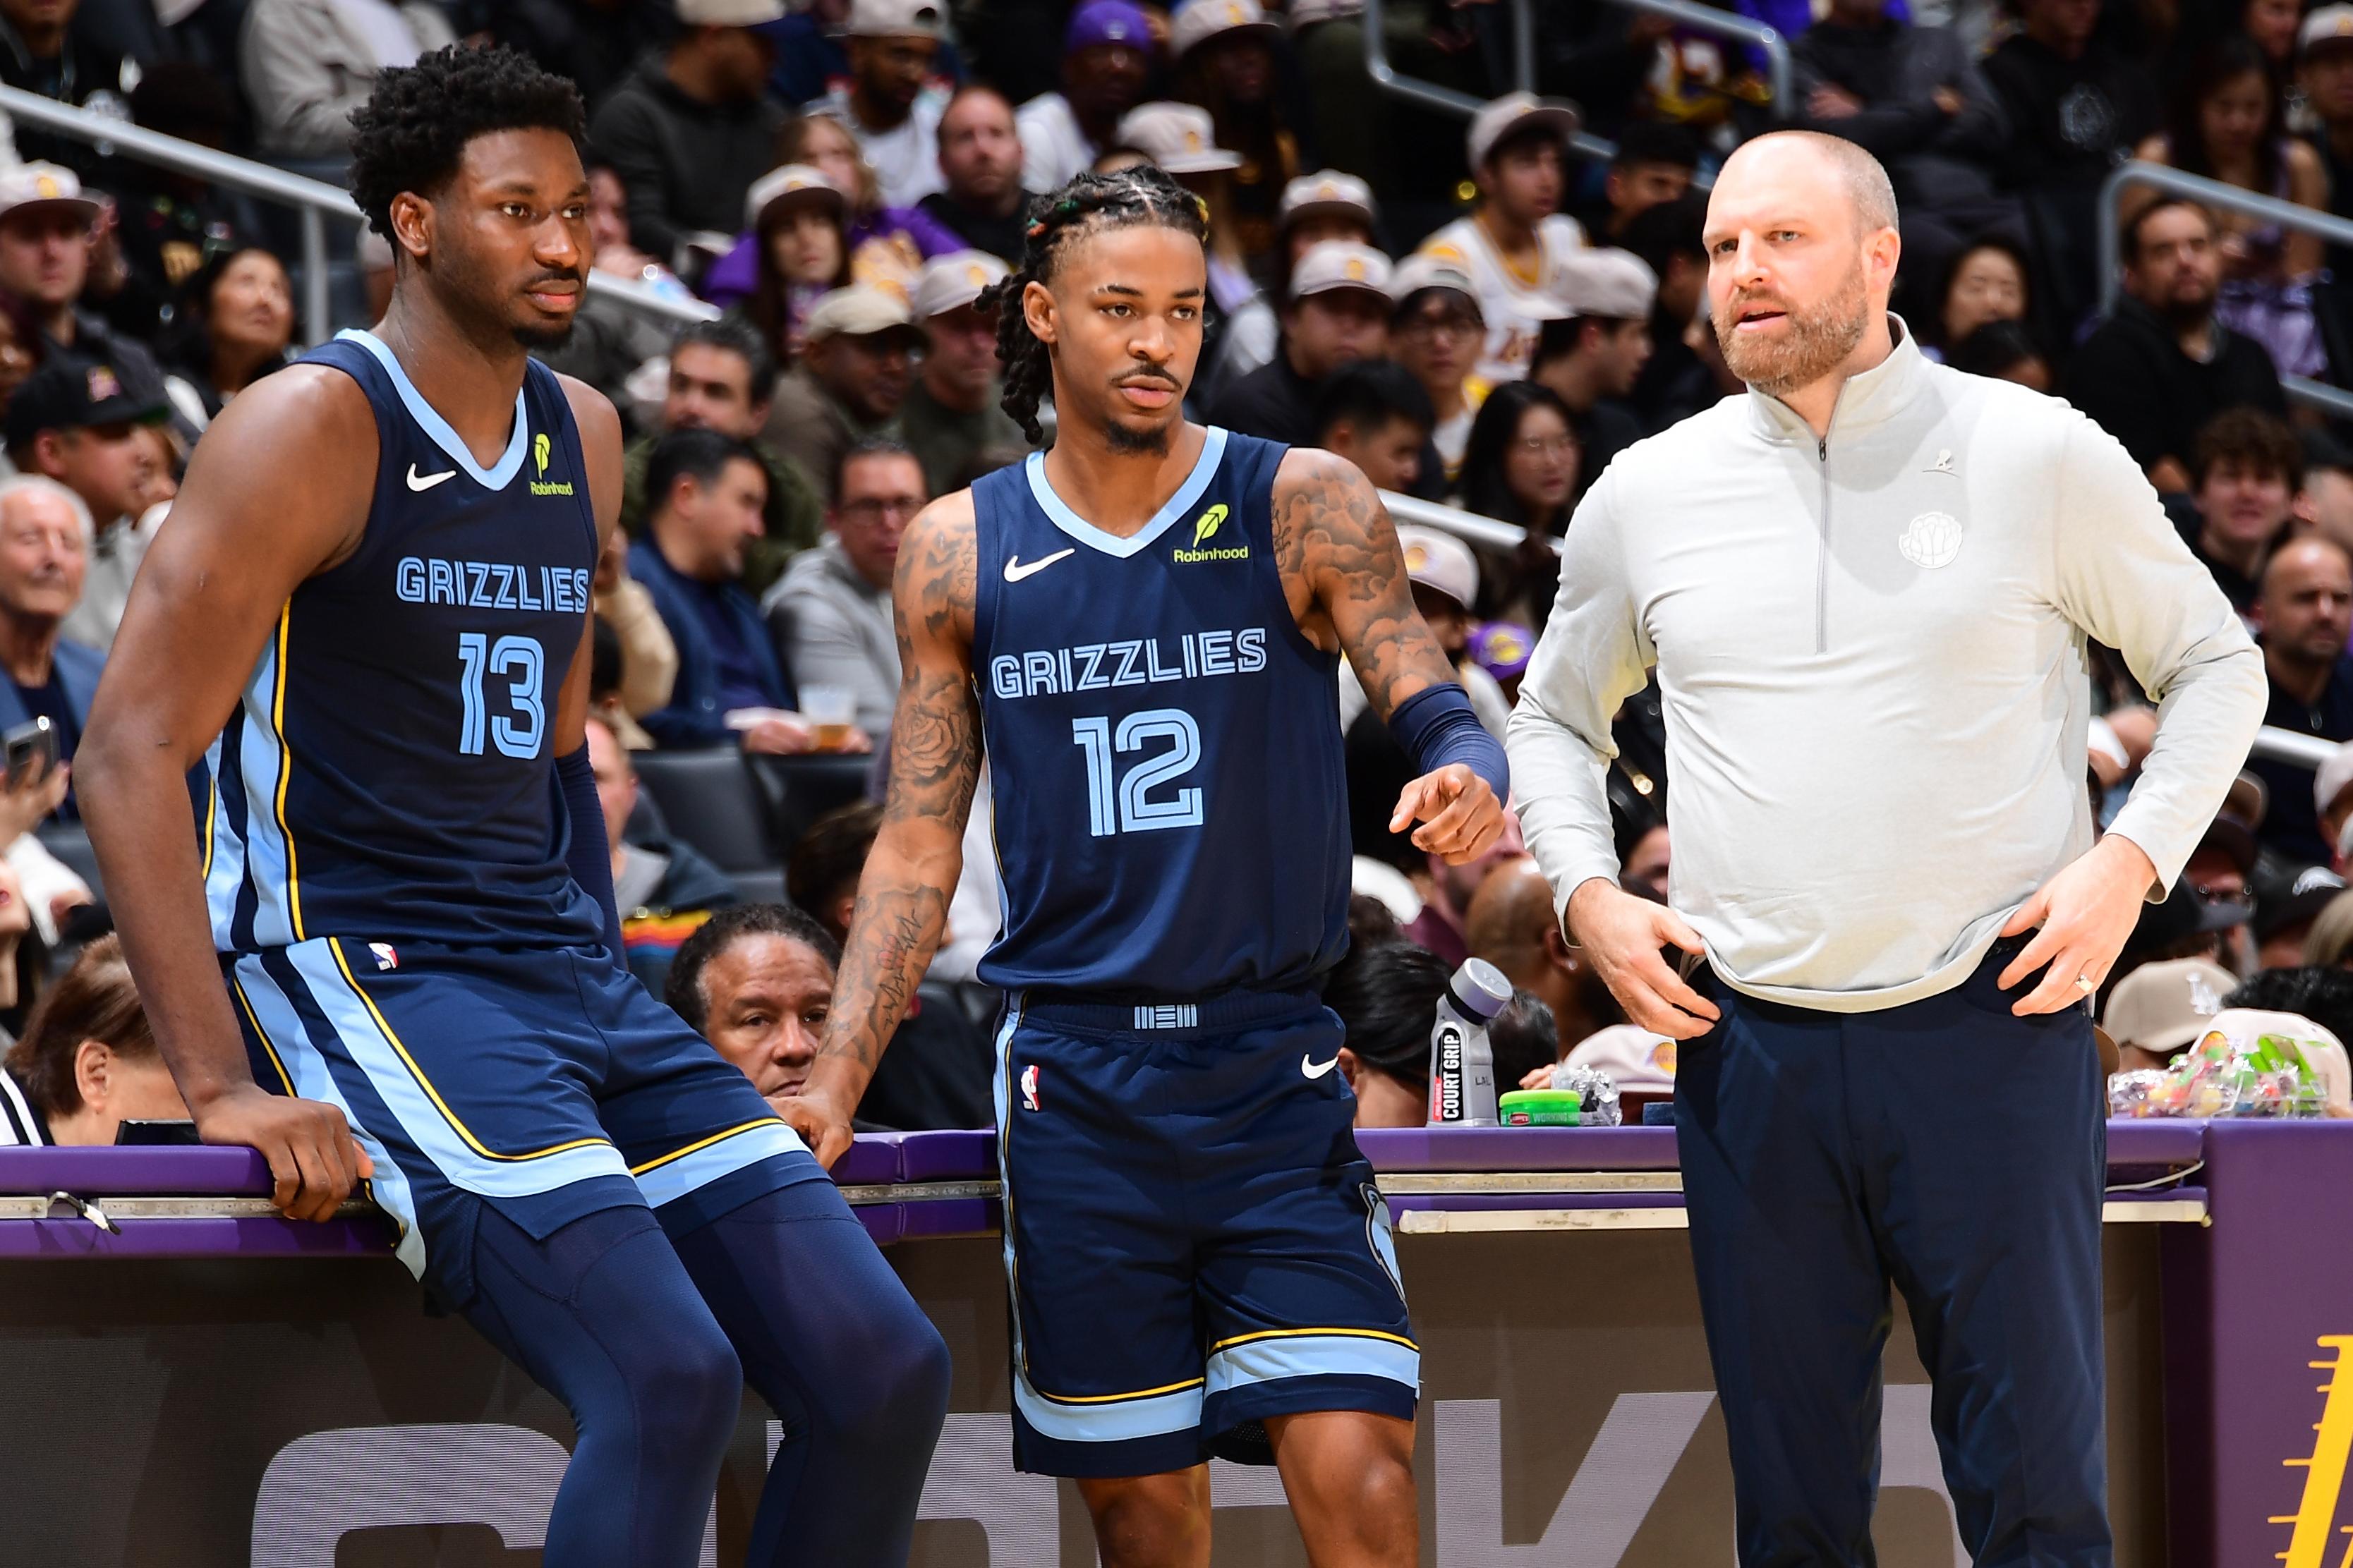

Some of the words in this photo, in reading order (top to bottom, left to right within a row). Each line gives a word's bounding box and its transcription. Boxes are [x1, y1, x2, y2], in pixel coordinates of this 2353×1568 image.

[530, 480, 574, 495] Robinhood
[1173, 545, 1249, 563] Robinhood
[396, 557, 588, 614] GRIZZLIES
[991, 628, 1267, 700] GRIZZLIES
[459, 632, 545, 760] 13
[1072, 708, 1204, 837] 12
[1443, 1034, 1460, 1069] GRIP
[1443, 1071, 1460, 1119] COURT
